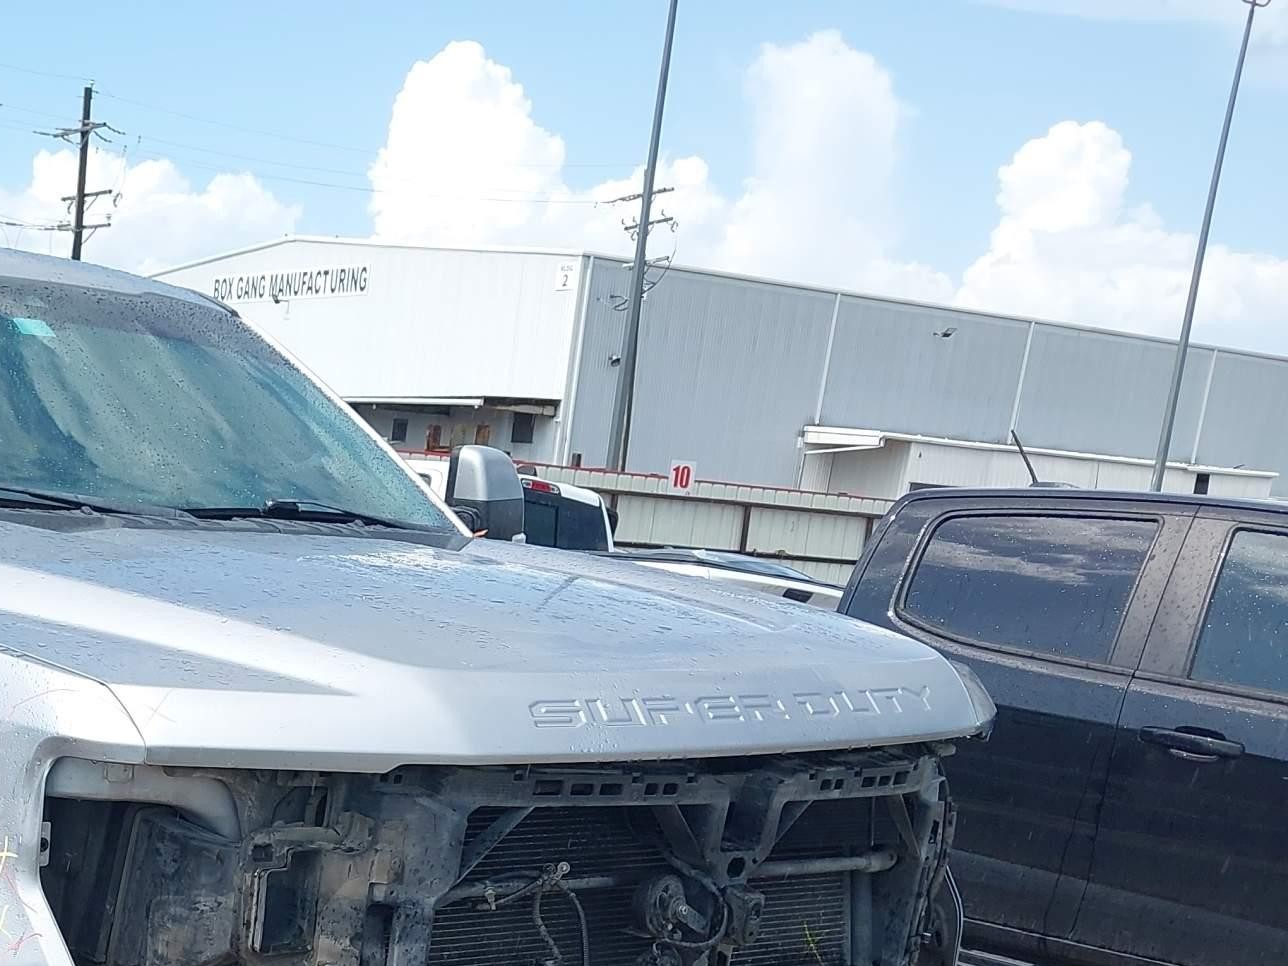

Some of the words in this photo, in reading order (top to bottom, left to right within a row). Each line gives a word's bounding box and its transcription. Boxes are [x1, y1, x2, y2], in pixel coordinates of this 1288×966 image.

[213, 277, 234, 300] BOX
[236, 275, 265, 299] GANG
[269, 267, 368, 297] MANUFACTURING
[562, 274, 569, 287] 2
[672, 464, 691, 489] 10
[528, 695, 791, 729] SUPER
[792, 686, 931, 718] DUTY
